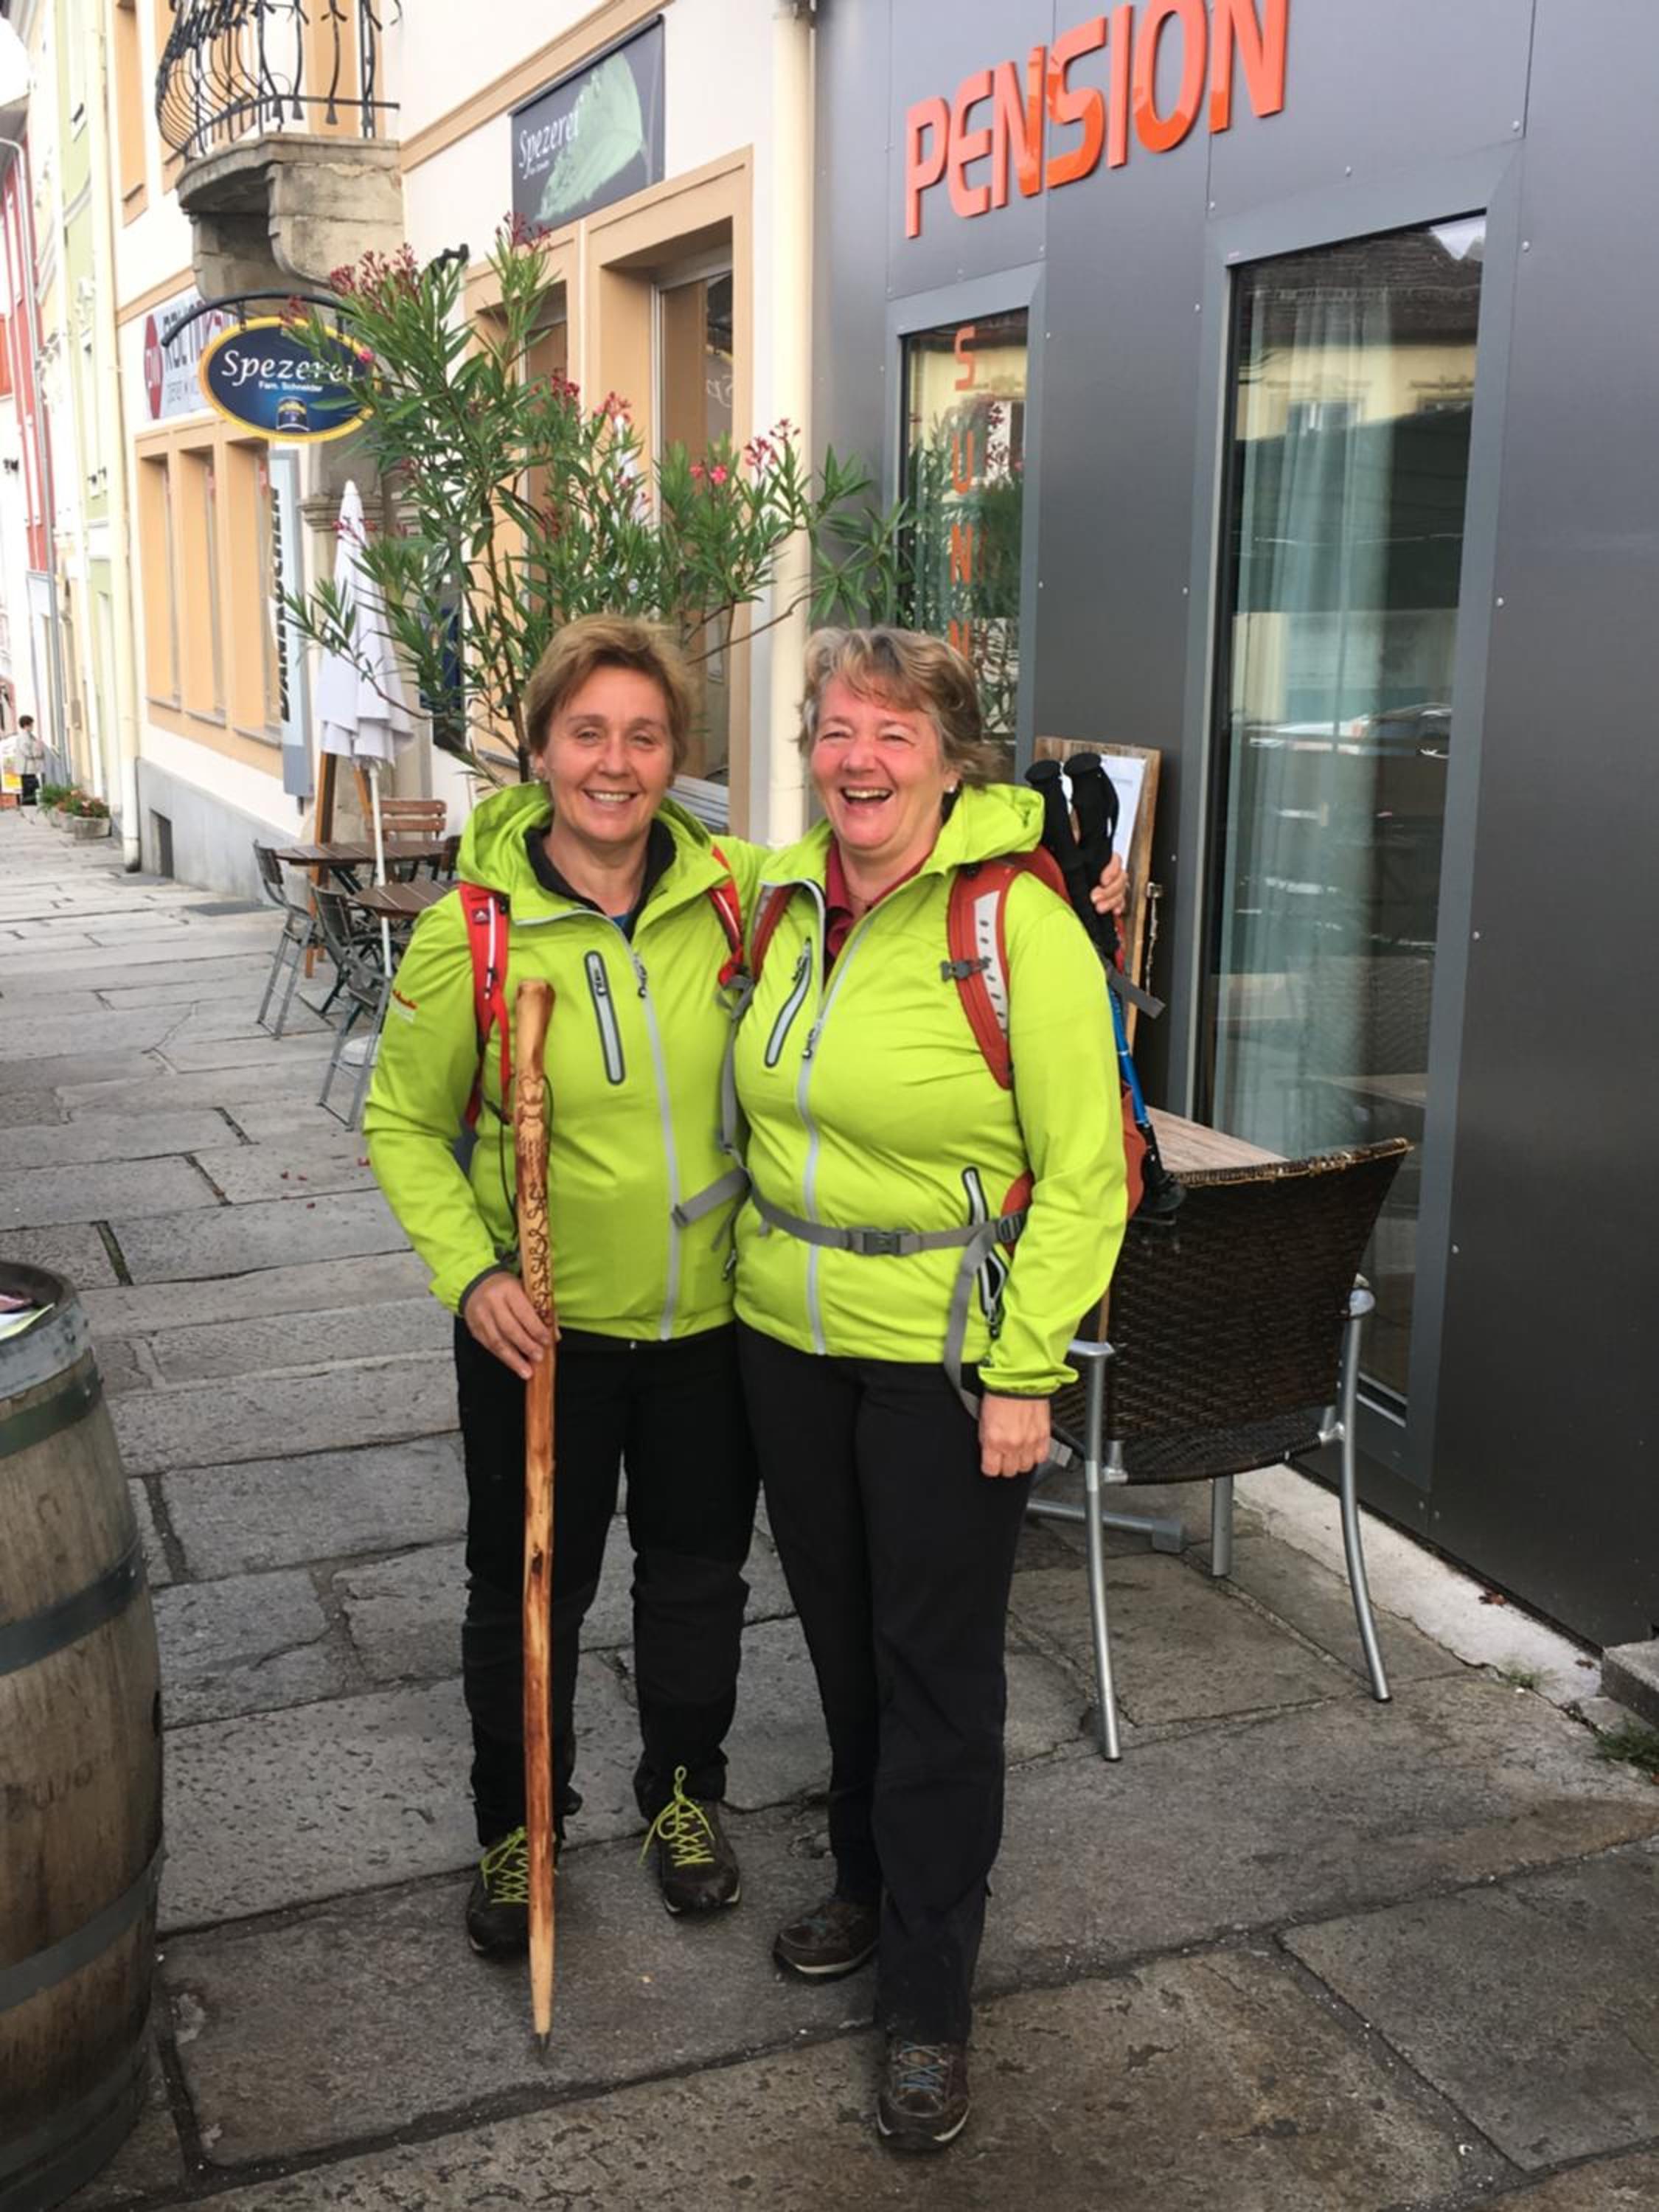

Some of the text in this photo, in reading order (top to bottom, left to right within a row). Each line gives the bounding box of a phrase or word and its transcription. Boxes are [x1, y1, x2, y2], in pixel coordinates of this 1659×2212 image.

[518, 108, 578, 179] Spezerei
[905, 0, 1290, 238] PENSION
[221, 350, 353, 386] Spezerei
